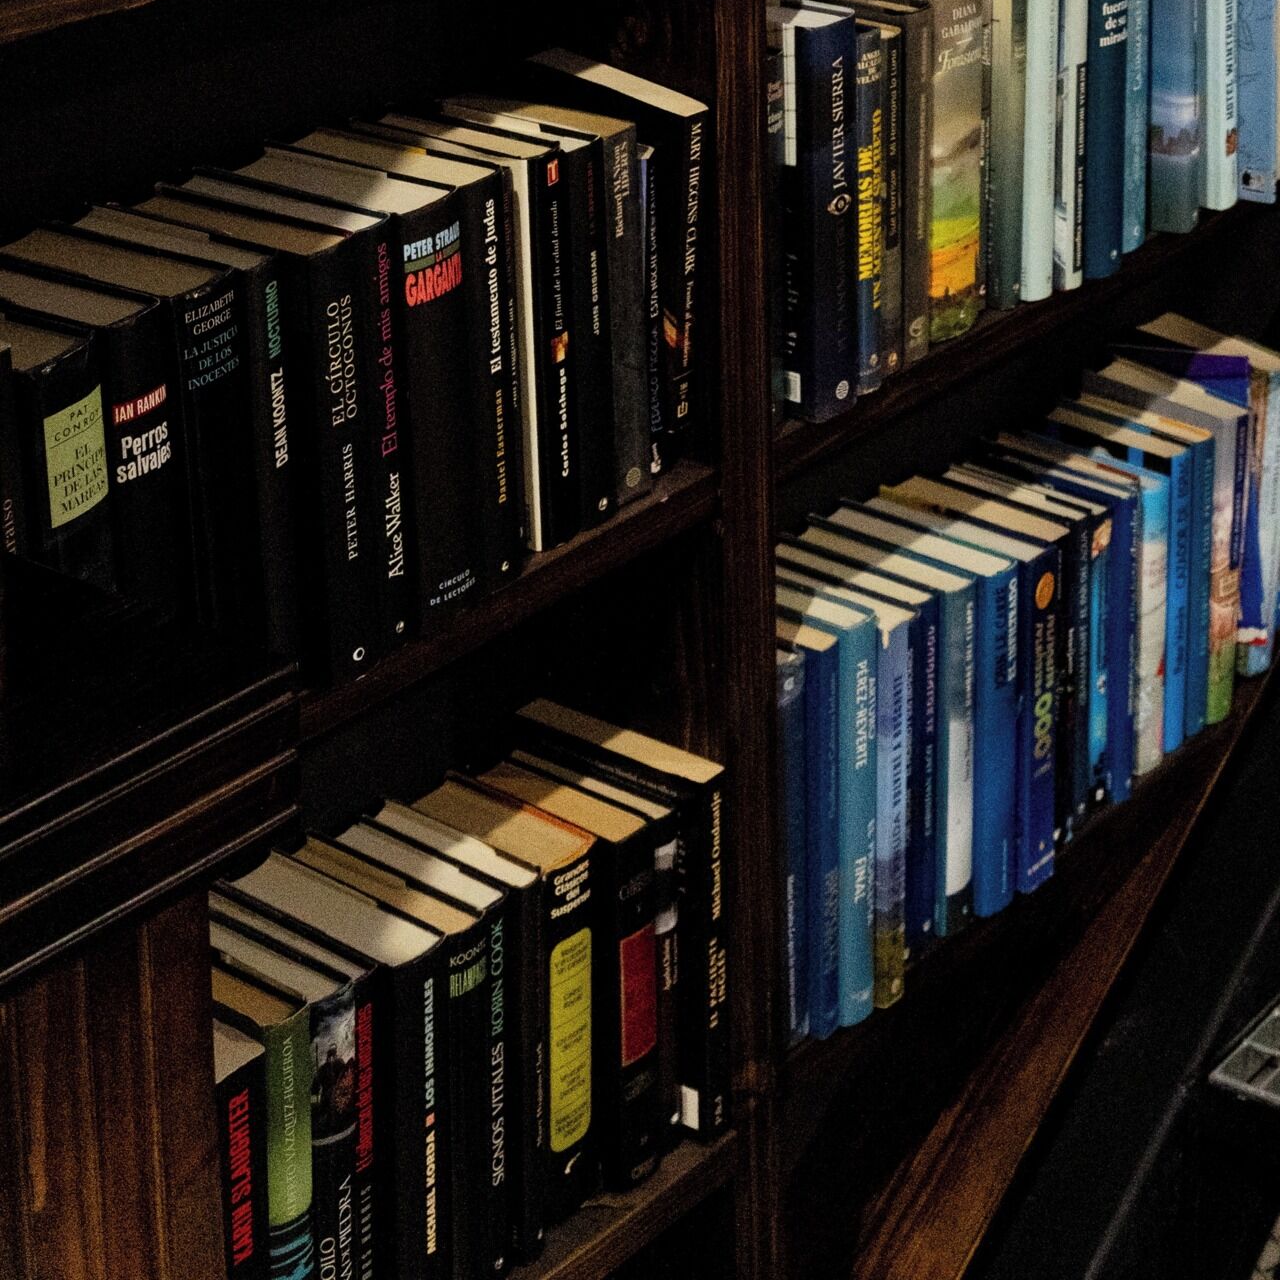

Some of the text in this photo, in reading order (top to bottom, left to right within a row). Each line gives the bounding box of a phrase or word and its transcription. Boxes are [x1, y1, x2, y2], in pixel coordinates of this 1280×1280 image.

[831, 56, 849, 190] JAVIER SIERRA
[403, 238, 433, 261] PETER
[486, 246, 497, 265] de
[185, 290, 235, 323] ELIZABETH
[193, 307, 232, 336] GEORGE
[264, 279, 281, 359] NOCTURNO
[487, 269, 502, 354] testamento
[326, 301, 345, 428] EL CÍRCULO
[340, 294, 357, 420] OCTOGONUS
[376, 242, 397, 458] El templo de mis amigos
[490, 357, 502, 376] El
[68, 403, 89, 421] PAT
[115, 401, 133, 423] IAN
[121, 420, 168, 459] Perros
[270, 367, 288, 469] DEAN KOONTZ
[115, 440, 171, 485] salvajes
[342, 443, 359, 561] PETER HARRIS
[385, 471, 405, 580] Alice Walker
[854, 857, 865, 903] FINAL
[489, 918, 503, 1036] ROBIN COOK
[424, 978, 434, 1108] LOS INMORTALES
[490, 1041, 506, 1187] SIGNOS VITALES
[425, 1130, 436, 1255] MICHAEL KORDA
